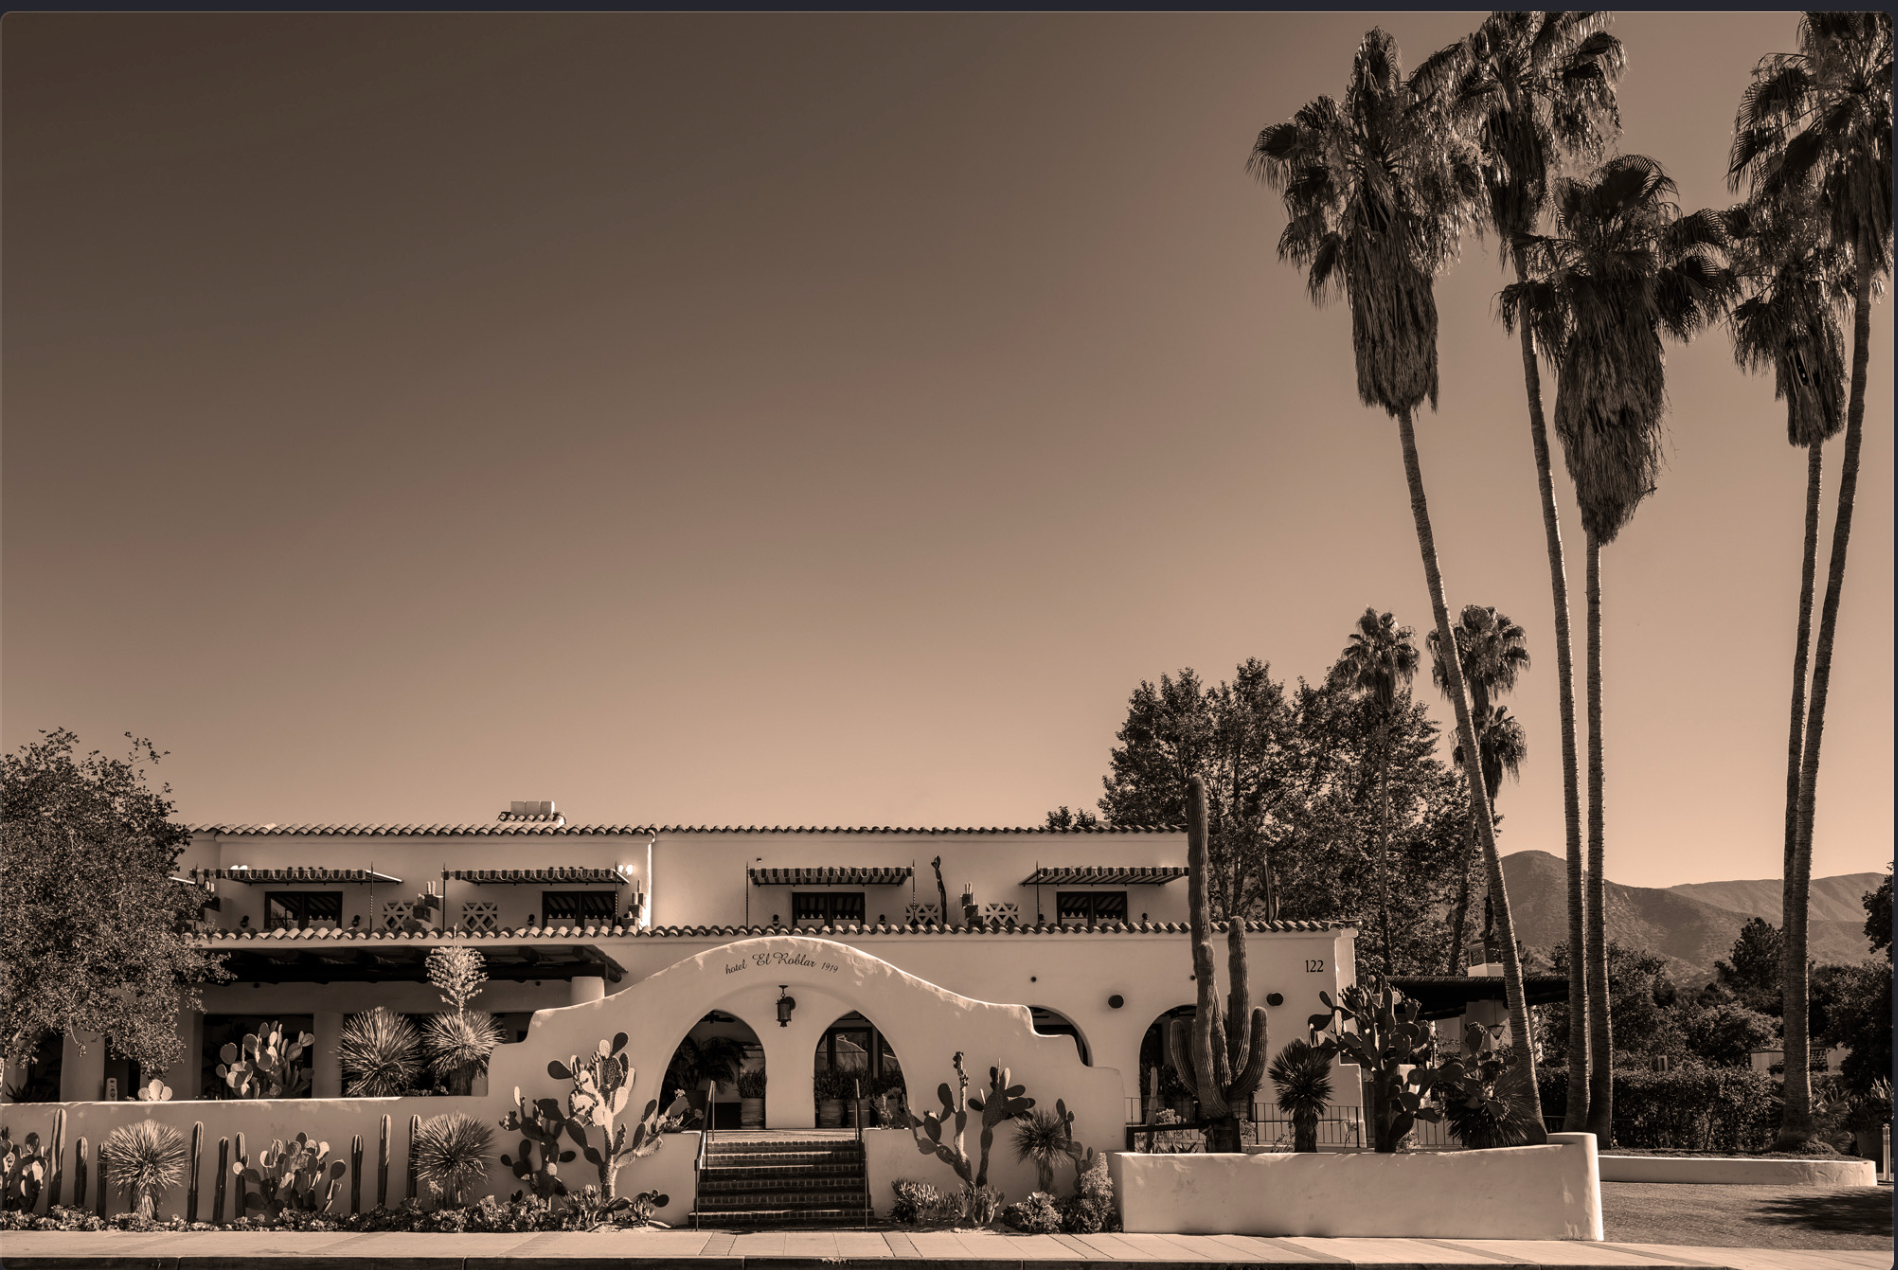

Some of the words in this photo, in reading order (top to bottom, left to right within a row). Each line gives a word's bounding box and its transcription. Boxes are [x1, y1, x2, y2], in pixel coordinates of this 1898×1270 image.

[725, 959, 747, 975] hotel
[752, 952, 772, 966] El
[773, 952, 817, 967] Roblar
[821, 962, 839, 973] 1919
[1305, 959, 1324, 973] 122
